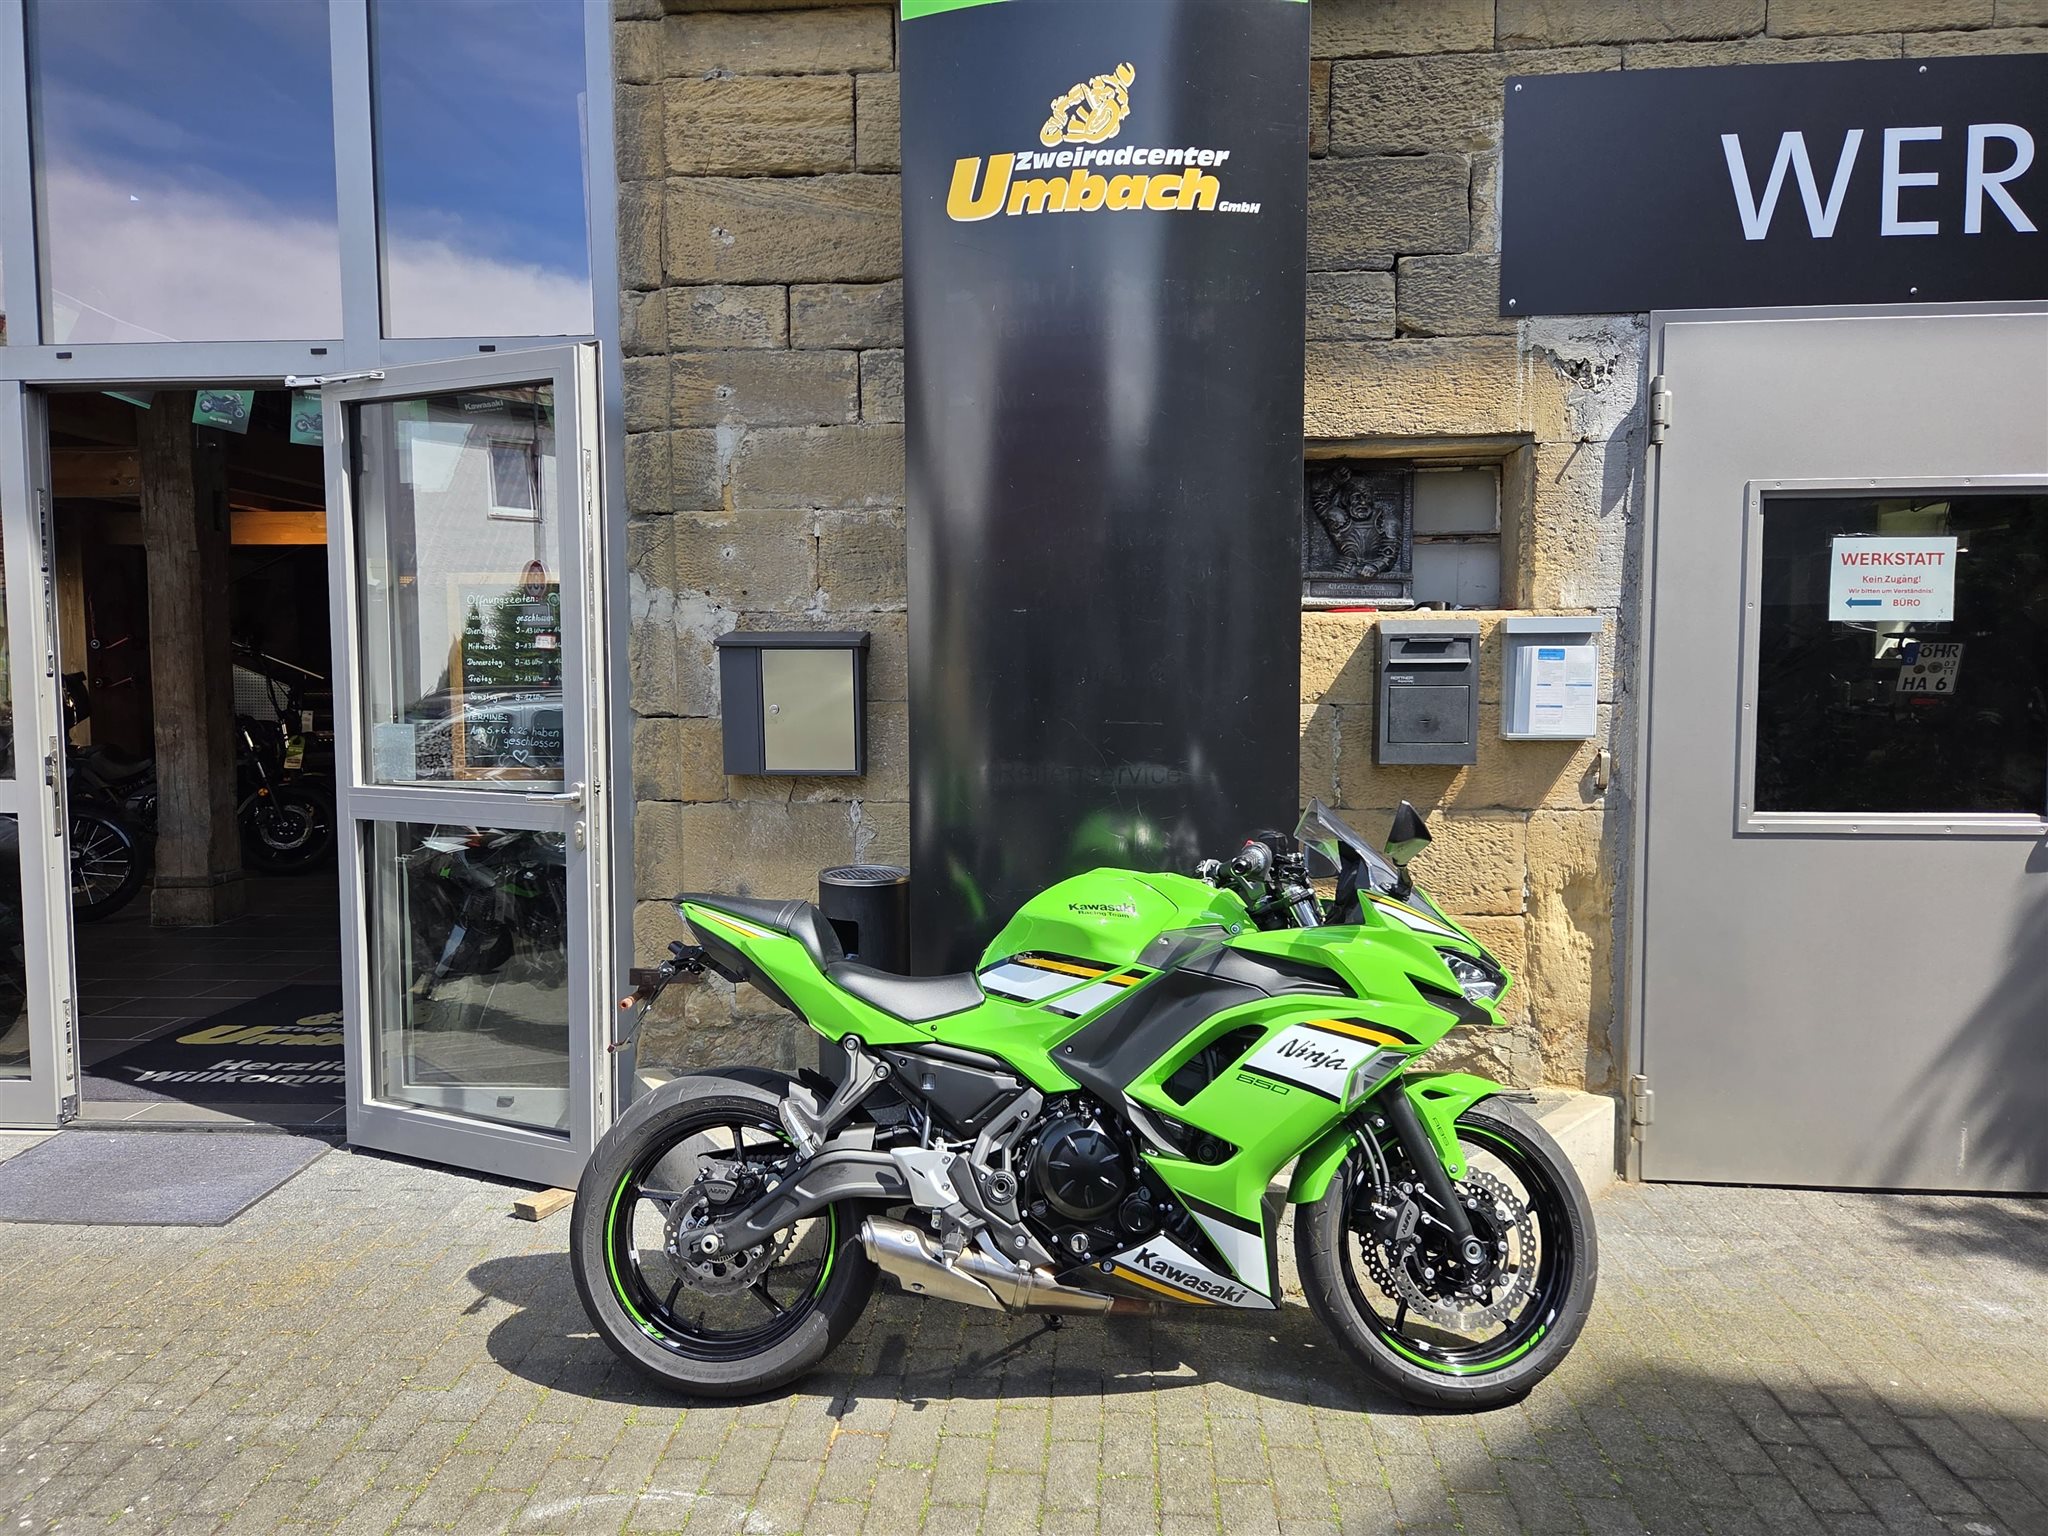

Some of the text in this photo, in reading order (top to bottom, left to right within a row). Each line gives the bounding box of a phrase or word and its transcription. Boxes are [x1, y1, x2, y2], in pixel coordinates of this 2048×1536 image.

[1014, 145, 1230, 170] Zweiradcenter
[946, 152, 1261, 222] Umbach GmbH
[1721, 123, 2038, 241] WER
[1841, 552, 1945, 566] WERKSTATT
[1862, 575, 1921, 585] Kein Zugang!
[1893, 597, 1921, 607] BÜRO
[1920, 644, 1959, 658] ÖHR
[1902, 677, 1947, 691] HA 6
[531, 727, 560, 738] haben
[503, 736, 560, 749] geschlossen
[1068, 903, 1136, 913] Kawasaki
[1276, 1039, 1348, 1070] Ninja
[1236, 1073, 1290, 1095] 650
[1133, 1247, 1248, 1303] Kawasaki
